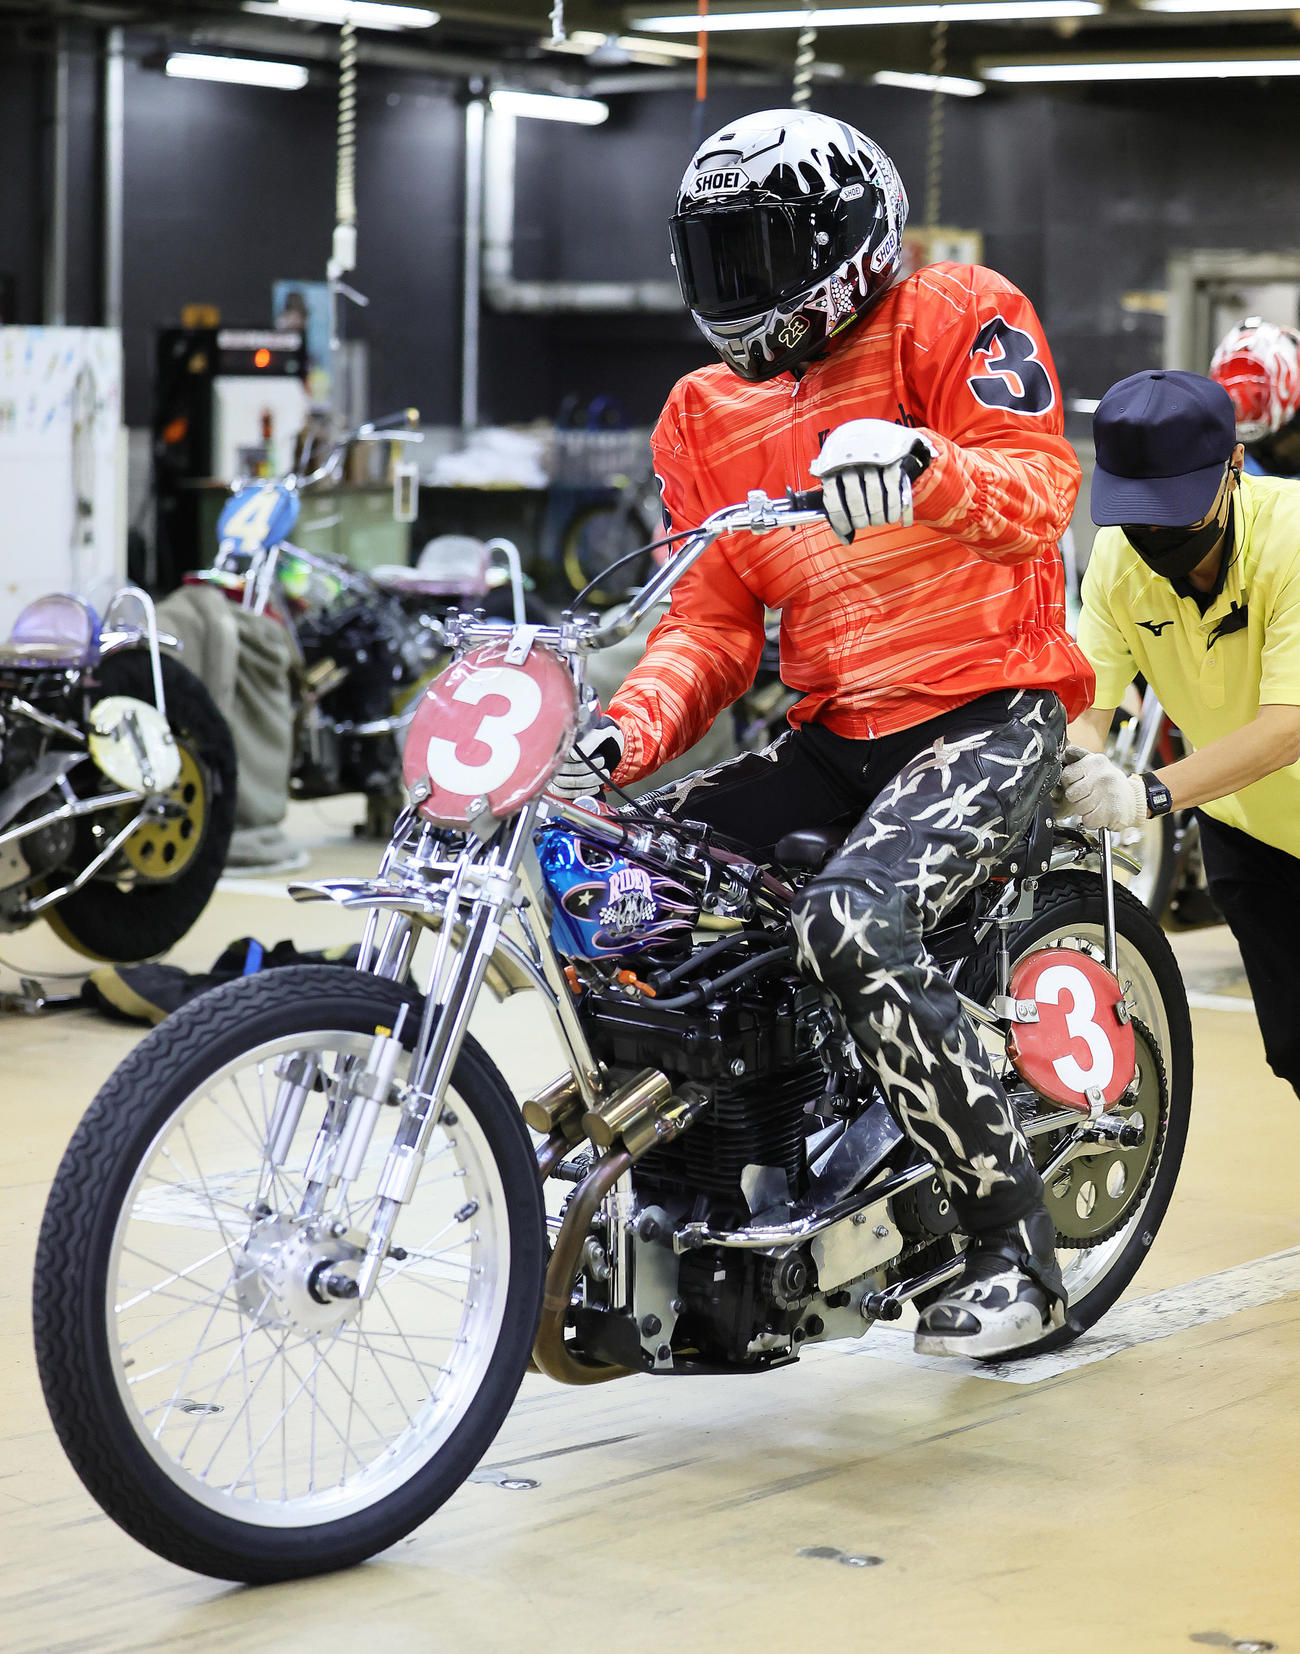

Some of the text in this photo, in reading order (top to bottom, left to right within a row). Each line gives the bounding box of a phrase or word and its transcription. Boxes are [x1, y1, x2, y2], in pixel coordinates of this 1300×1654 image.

[695, 172, 740, 193] SHOEI
[844, 186, 861, 199] SHOEI
[875, 235, 895, 267] SHOEI
[778, 315, 811, 349] 23
[967, 315, 1055, 416] 3
[223, 486, 280, 553] 4
[426, 666, 543, 796] 3
[607, 868, 654, 906] RIDER
[1035, 964, 1114, 1094] 3
